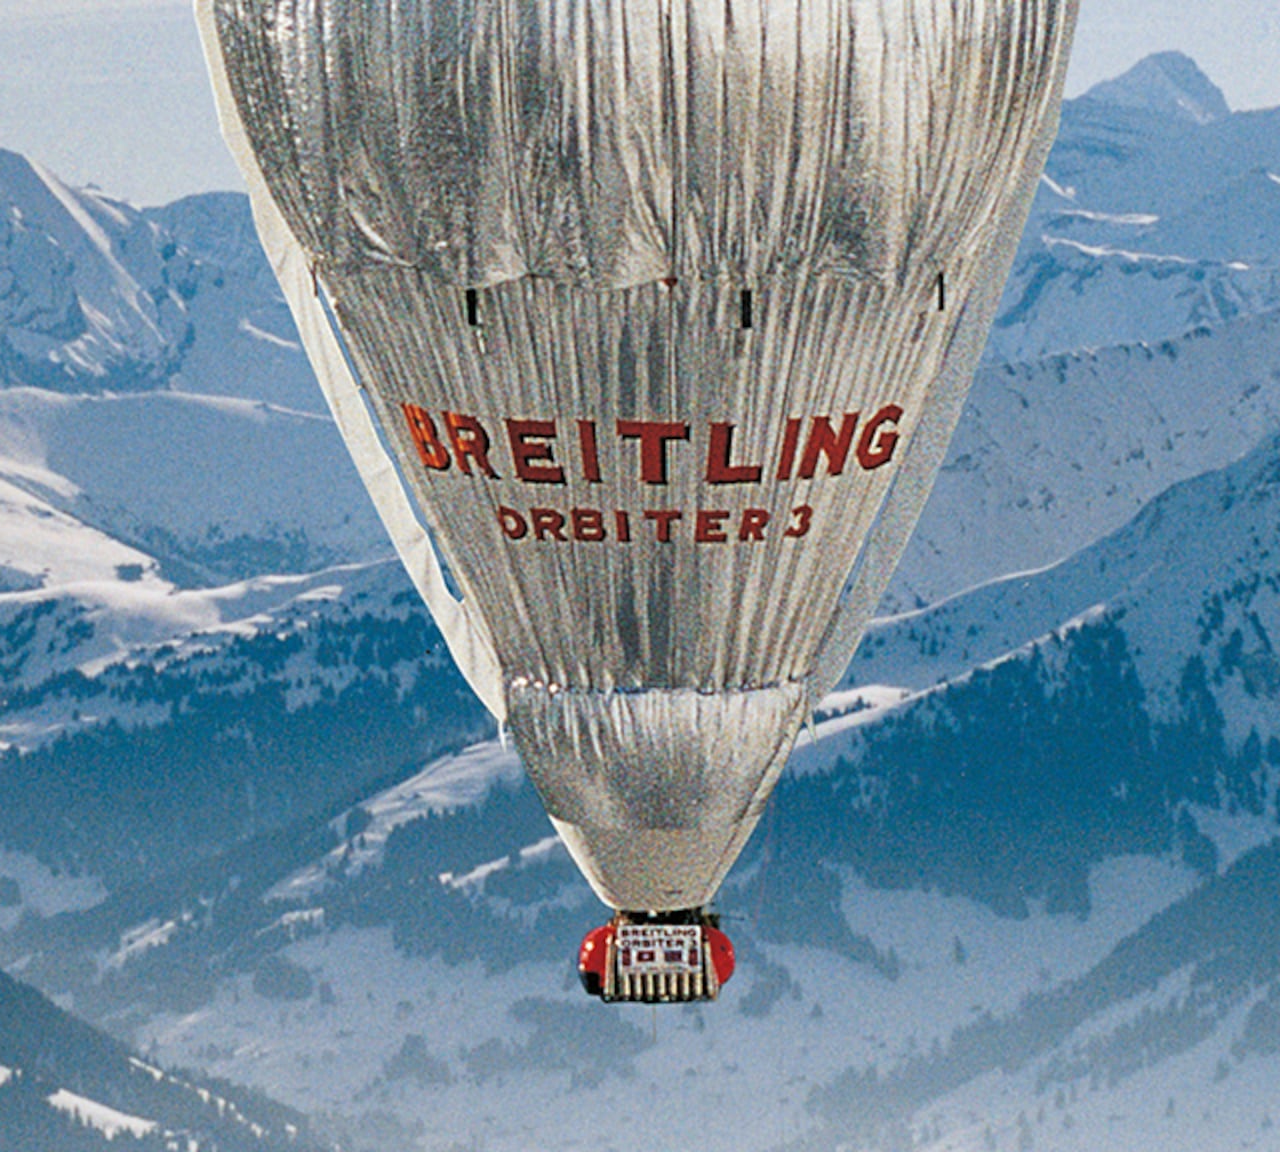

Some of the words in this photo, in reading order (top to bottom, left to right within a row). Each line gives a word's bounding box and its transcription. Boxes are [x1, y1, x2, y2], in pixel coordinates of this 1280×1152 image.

[402, 403, 904, 485] BREITLING
[497, 506, 771, 543] ORBITER
[784, 505, 813, 539] 3
[621, 928, 697, 937] BREITLING
[621, 939, 685, 948] ORBITER
